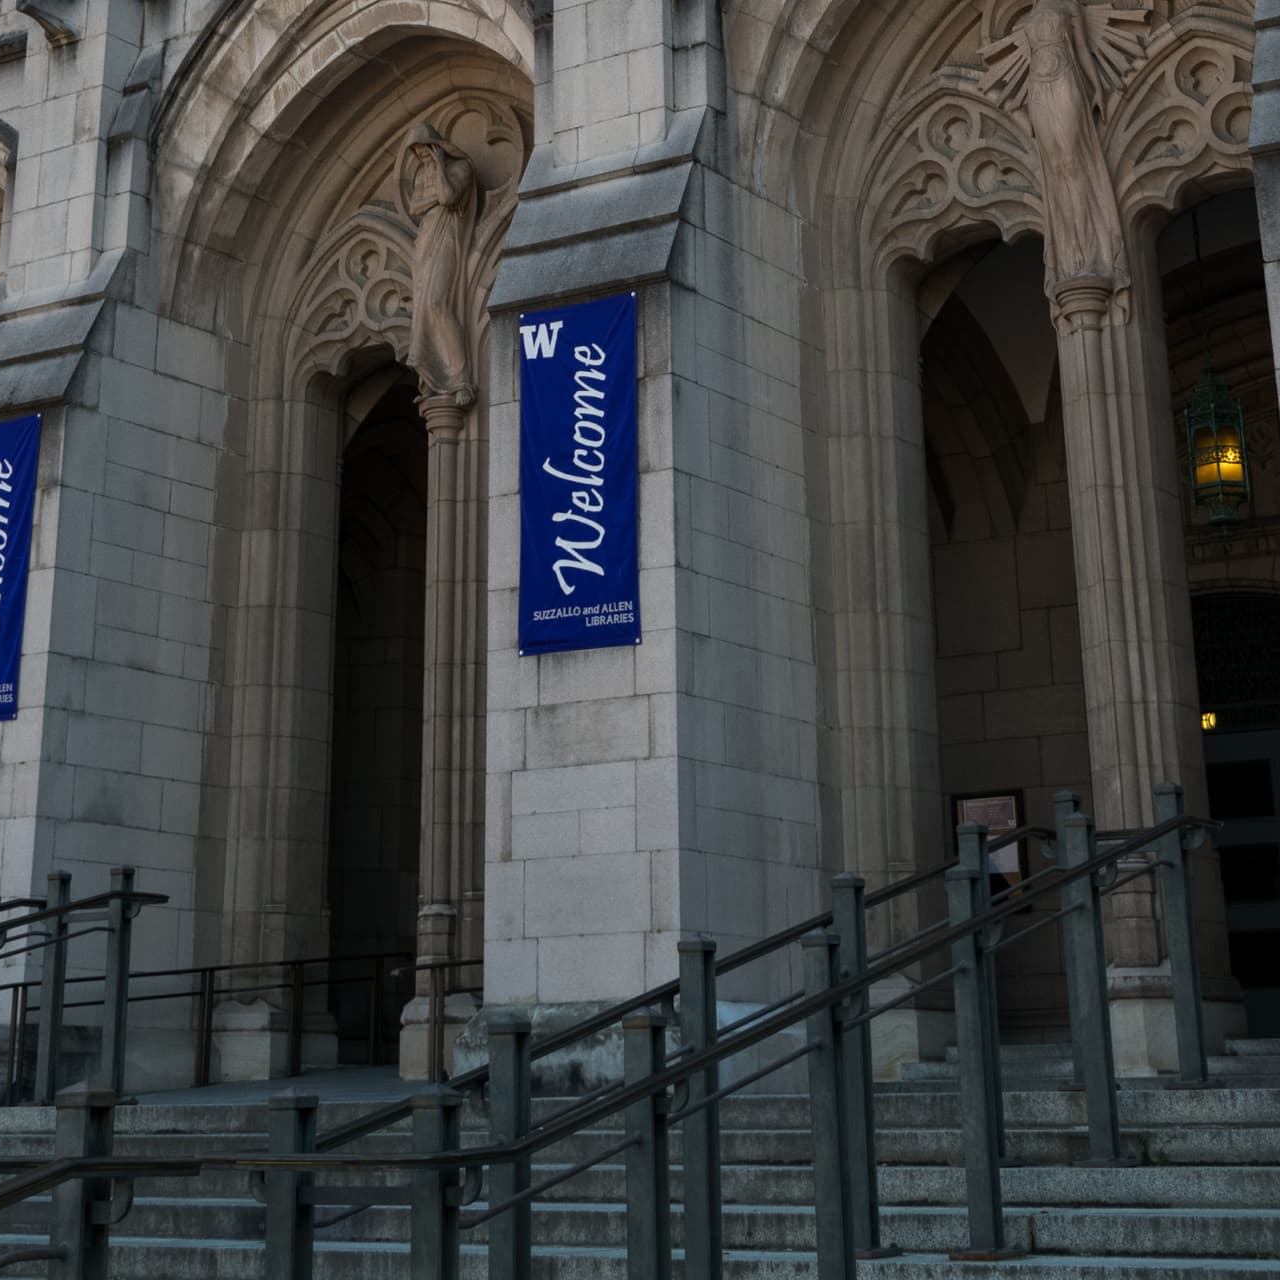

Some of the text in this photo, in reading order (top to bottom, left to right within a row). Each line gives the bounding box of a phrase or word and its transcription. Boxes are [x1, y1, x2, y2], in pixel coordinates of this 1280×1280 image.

[520, 320, 563, 360] W
[542, 343, 607, 596] Welcome
[533, 601, 633, 621] SUZZALLO and ALLEN
[585, 613, 634, 627] LIBRARIES
